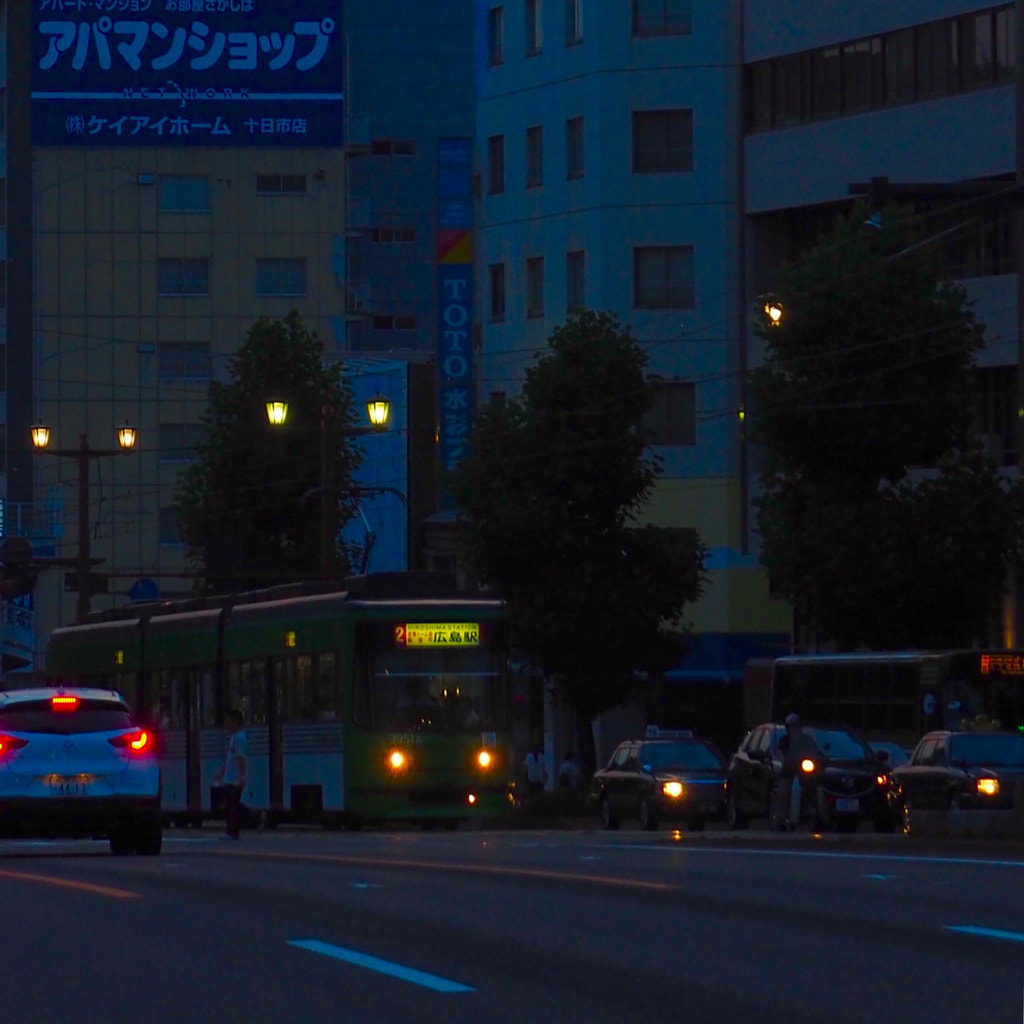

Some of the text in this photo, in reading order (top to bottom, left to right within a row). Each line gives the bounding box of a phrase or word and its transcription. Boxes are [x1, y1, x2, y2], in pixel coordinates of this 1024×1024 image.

[38, 16, 335, 71] アパマンショップ
[243, 118, 308, 134] 十日市店
[443, 278, 468, 377] TOTO
[395, 626, 404, 643] 2
[433, 631, 478, 643] 広島駅
